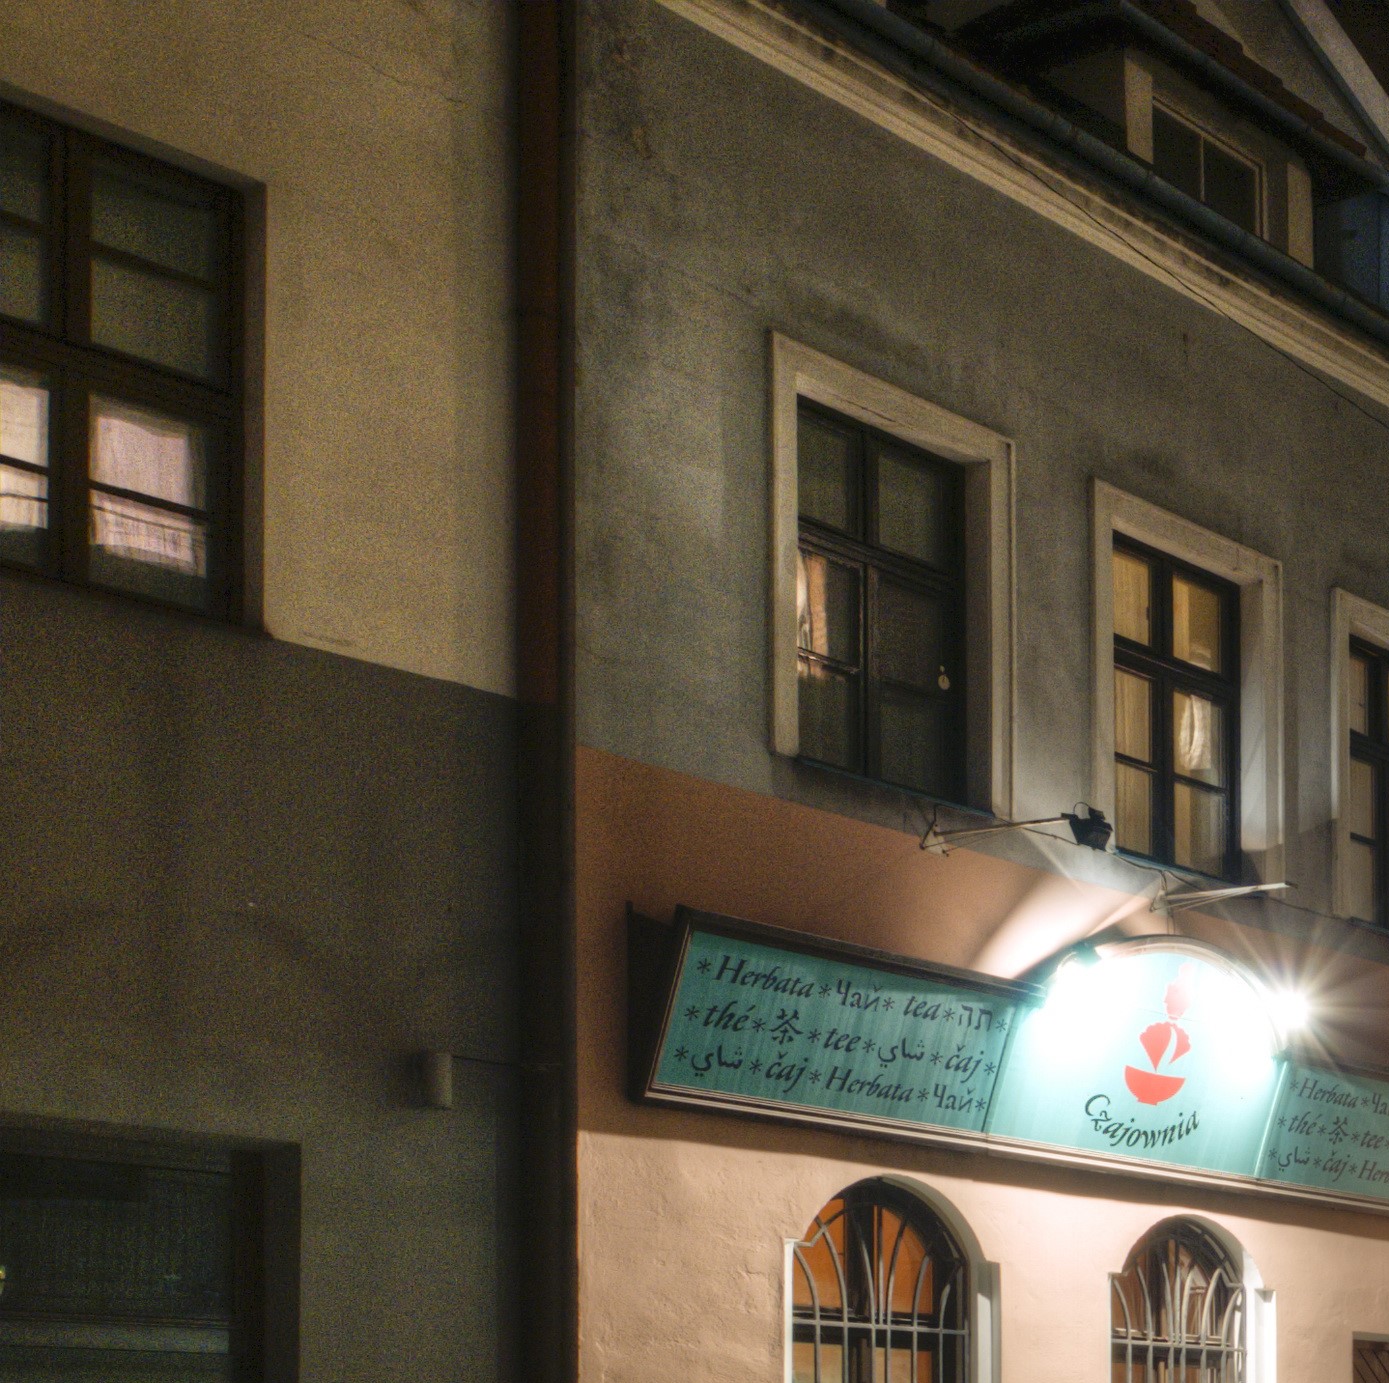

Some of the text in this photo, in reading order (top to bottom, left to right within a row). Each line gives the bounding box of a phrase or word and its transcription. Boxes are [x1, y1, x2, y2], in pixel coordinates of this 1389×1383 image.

[712, 955, 993, 1031] Herbata Чай tea תה
[703, 1001, 756, 1032] thé
[770, 1008, 804, 1045] 茶
[824, 1028, 861, 1053] tee
[945, 1043, 984, 1083] čaj
[765, 1052, 808, 1093] čaj
[825, 1066, 914, 1103] Herbata
[934, 1083, 976, 1113] Чай
[1298, 1077, 1359, 1108] Herbata
[1288, 1111, 1323, 1135] thé
[1328, 1116, 1349, 1145] 茶
[1360, 1130, 1384, 1149] tee
[1322, 1150, 1350, 1182] čaj
